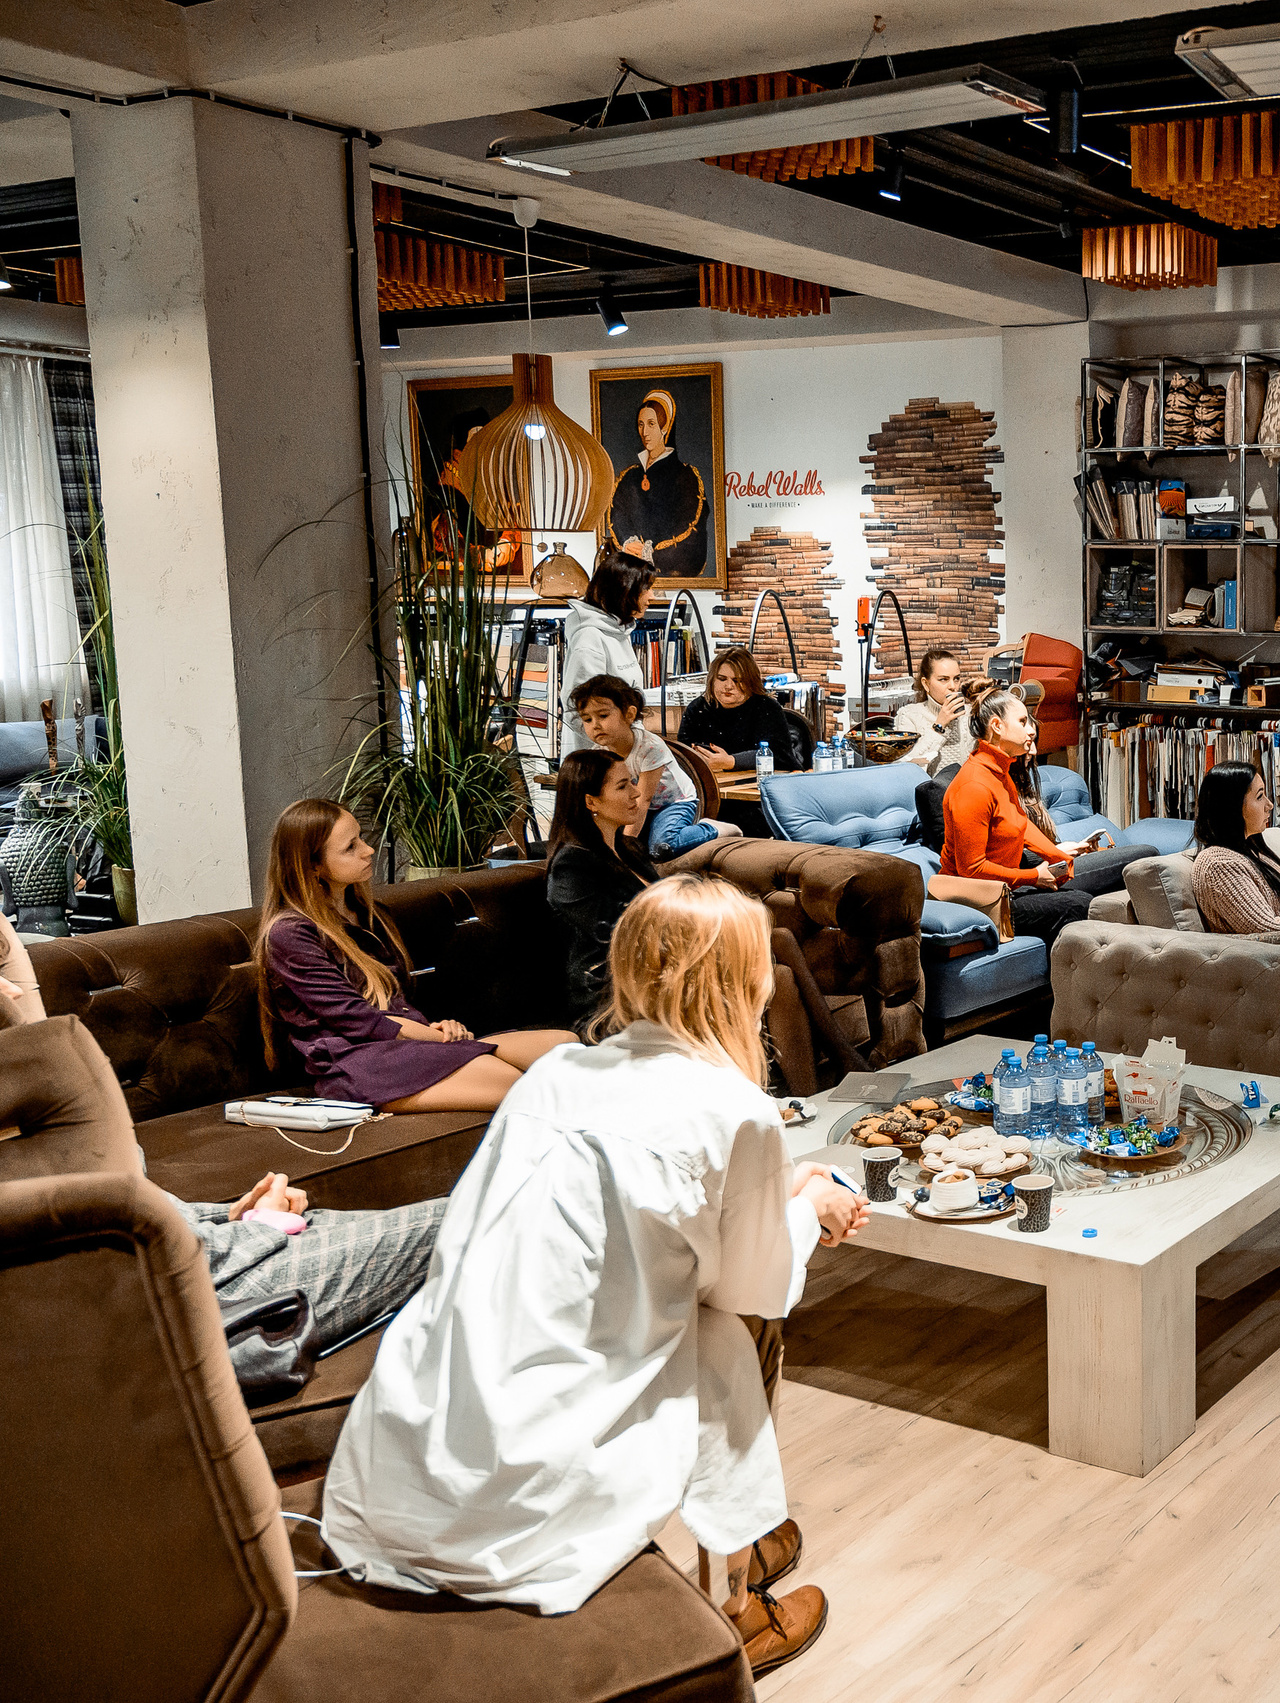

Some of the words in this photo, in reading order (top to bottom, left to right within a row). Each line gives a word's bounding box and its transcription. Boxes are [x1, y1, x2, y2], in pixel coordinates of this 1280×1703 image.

[725, 471, 772, 500] Rebel
[773, 469, 825, 496] Walls
[1124, 1094, 1158, 1105] Raffaello
